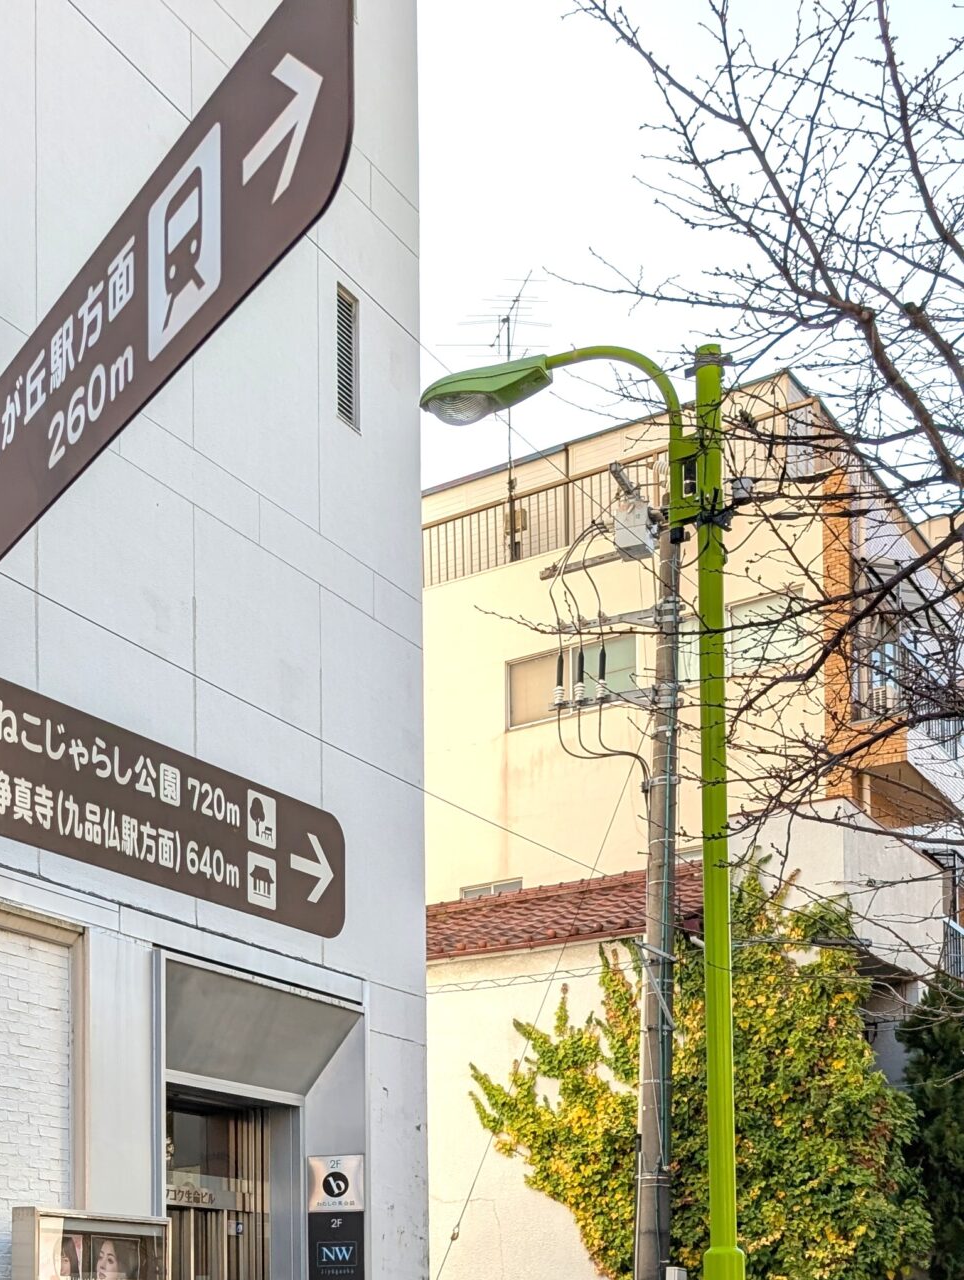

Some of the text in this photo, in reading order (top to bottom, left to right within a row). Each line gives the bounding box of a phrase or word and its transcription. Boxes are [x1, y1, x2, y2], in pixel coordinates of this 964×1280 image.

[48, 344, 134, 470] 260m
[187, 777, 240, 828] 720m
[186, 844, 240, 889] 640m
[330, 1160, 341, 1169] 2F
[330, 1218, 343, 1228] 2F
[321, 1246, 354, 1262] NW
